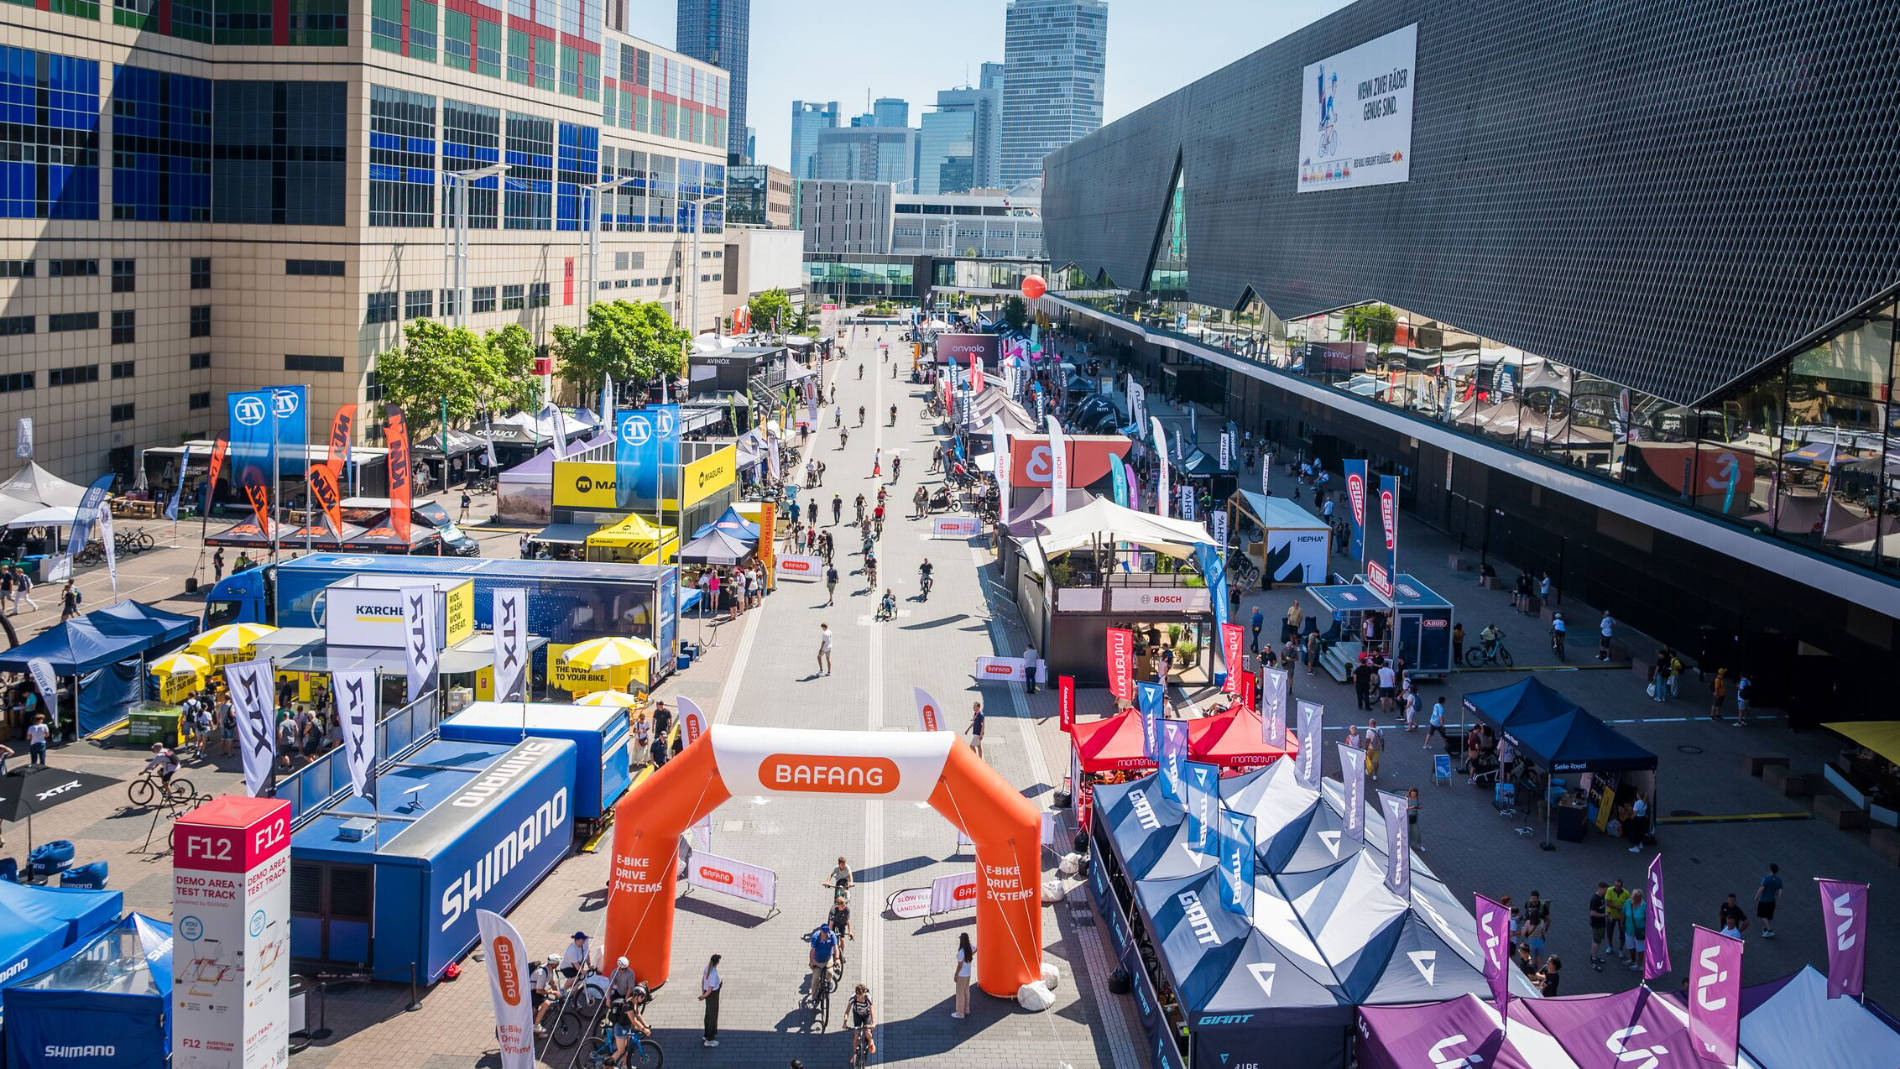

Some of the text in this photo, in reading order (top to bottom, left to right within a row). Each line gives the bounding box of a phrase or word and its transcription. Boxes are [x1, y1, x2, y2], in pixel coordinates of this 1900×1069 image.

[1358, 67, 1408, 100] WENN ZWEI RÄDER
[1364, 96, 1398, 120] GENUG SIND.
[564, 262, 572, 277] 10
[1370, 566, 1390, 592] ABUS
[1118, 759, 1157, 767] momentu
[1230, 755, 1276, 764] momentum
[452, 742, 552, 807] SHIMANO
[775, 764, 883, 786] BAFANG
[36, 780, 82, 801] XTR
[1128, 788, 1162, 830] GIANT
[255, 818, 285, 855] F12
[187, 835, 232, 861] F12
[442, 786, 568, 932] SHIMANO
[616, 854, 650, 868] E-BIKE
[247, 868, 268, 886] DEMO
[269, 856, 286, 874] AREA
[616, 868, 646, 881] DRIVE
[986, 865, 1020, 876] E-BIKE
[176, 876, 206, 887] DEMO
[208, 878, 235, 889] AREA
[248, 868, 286, 896] TEST TRACK
[615, 880, 662, 893] SYSTEMS
[986, 878, 1019, 888] DRIVE
[176, 886, 236, 900] TEST TRACK
[959, 887, 976, 896] BAF
[986, 888, 1033, 901] SYSTEMS
[1178, 890, 1222, 945] GIANT
[498, 944, 516, 999] BAFANG
[1198, 1014, 1255, 1025] GIANT
[183, 1038, 200, 1048] F12
[45, 1046, 115, 1058] SHIMANO
